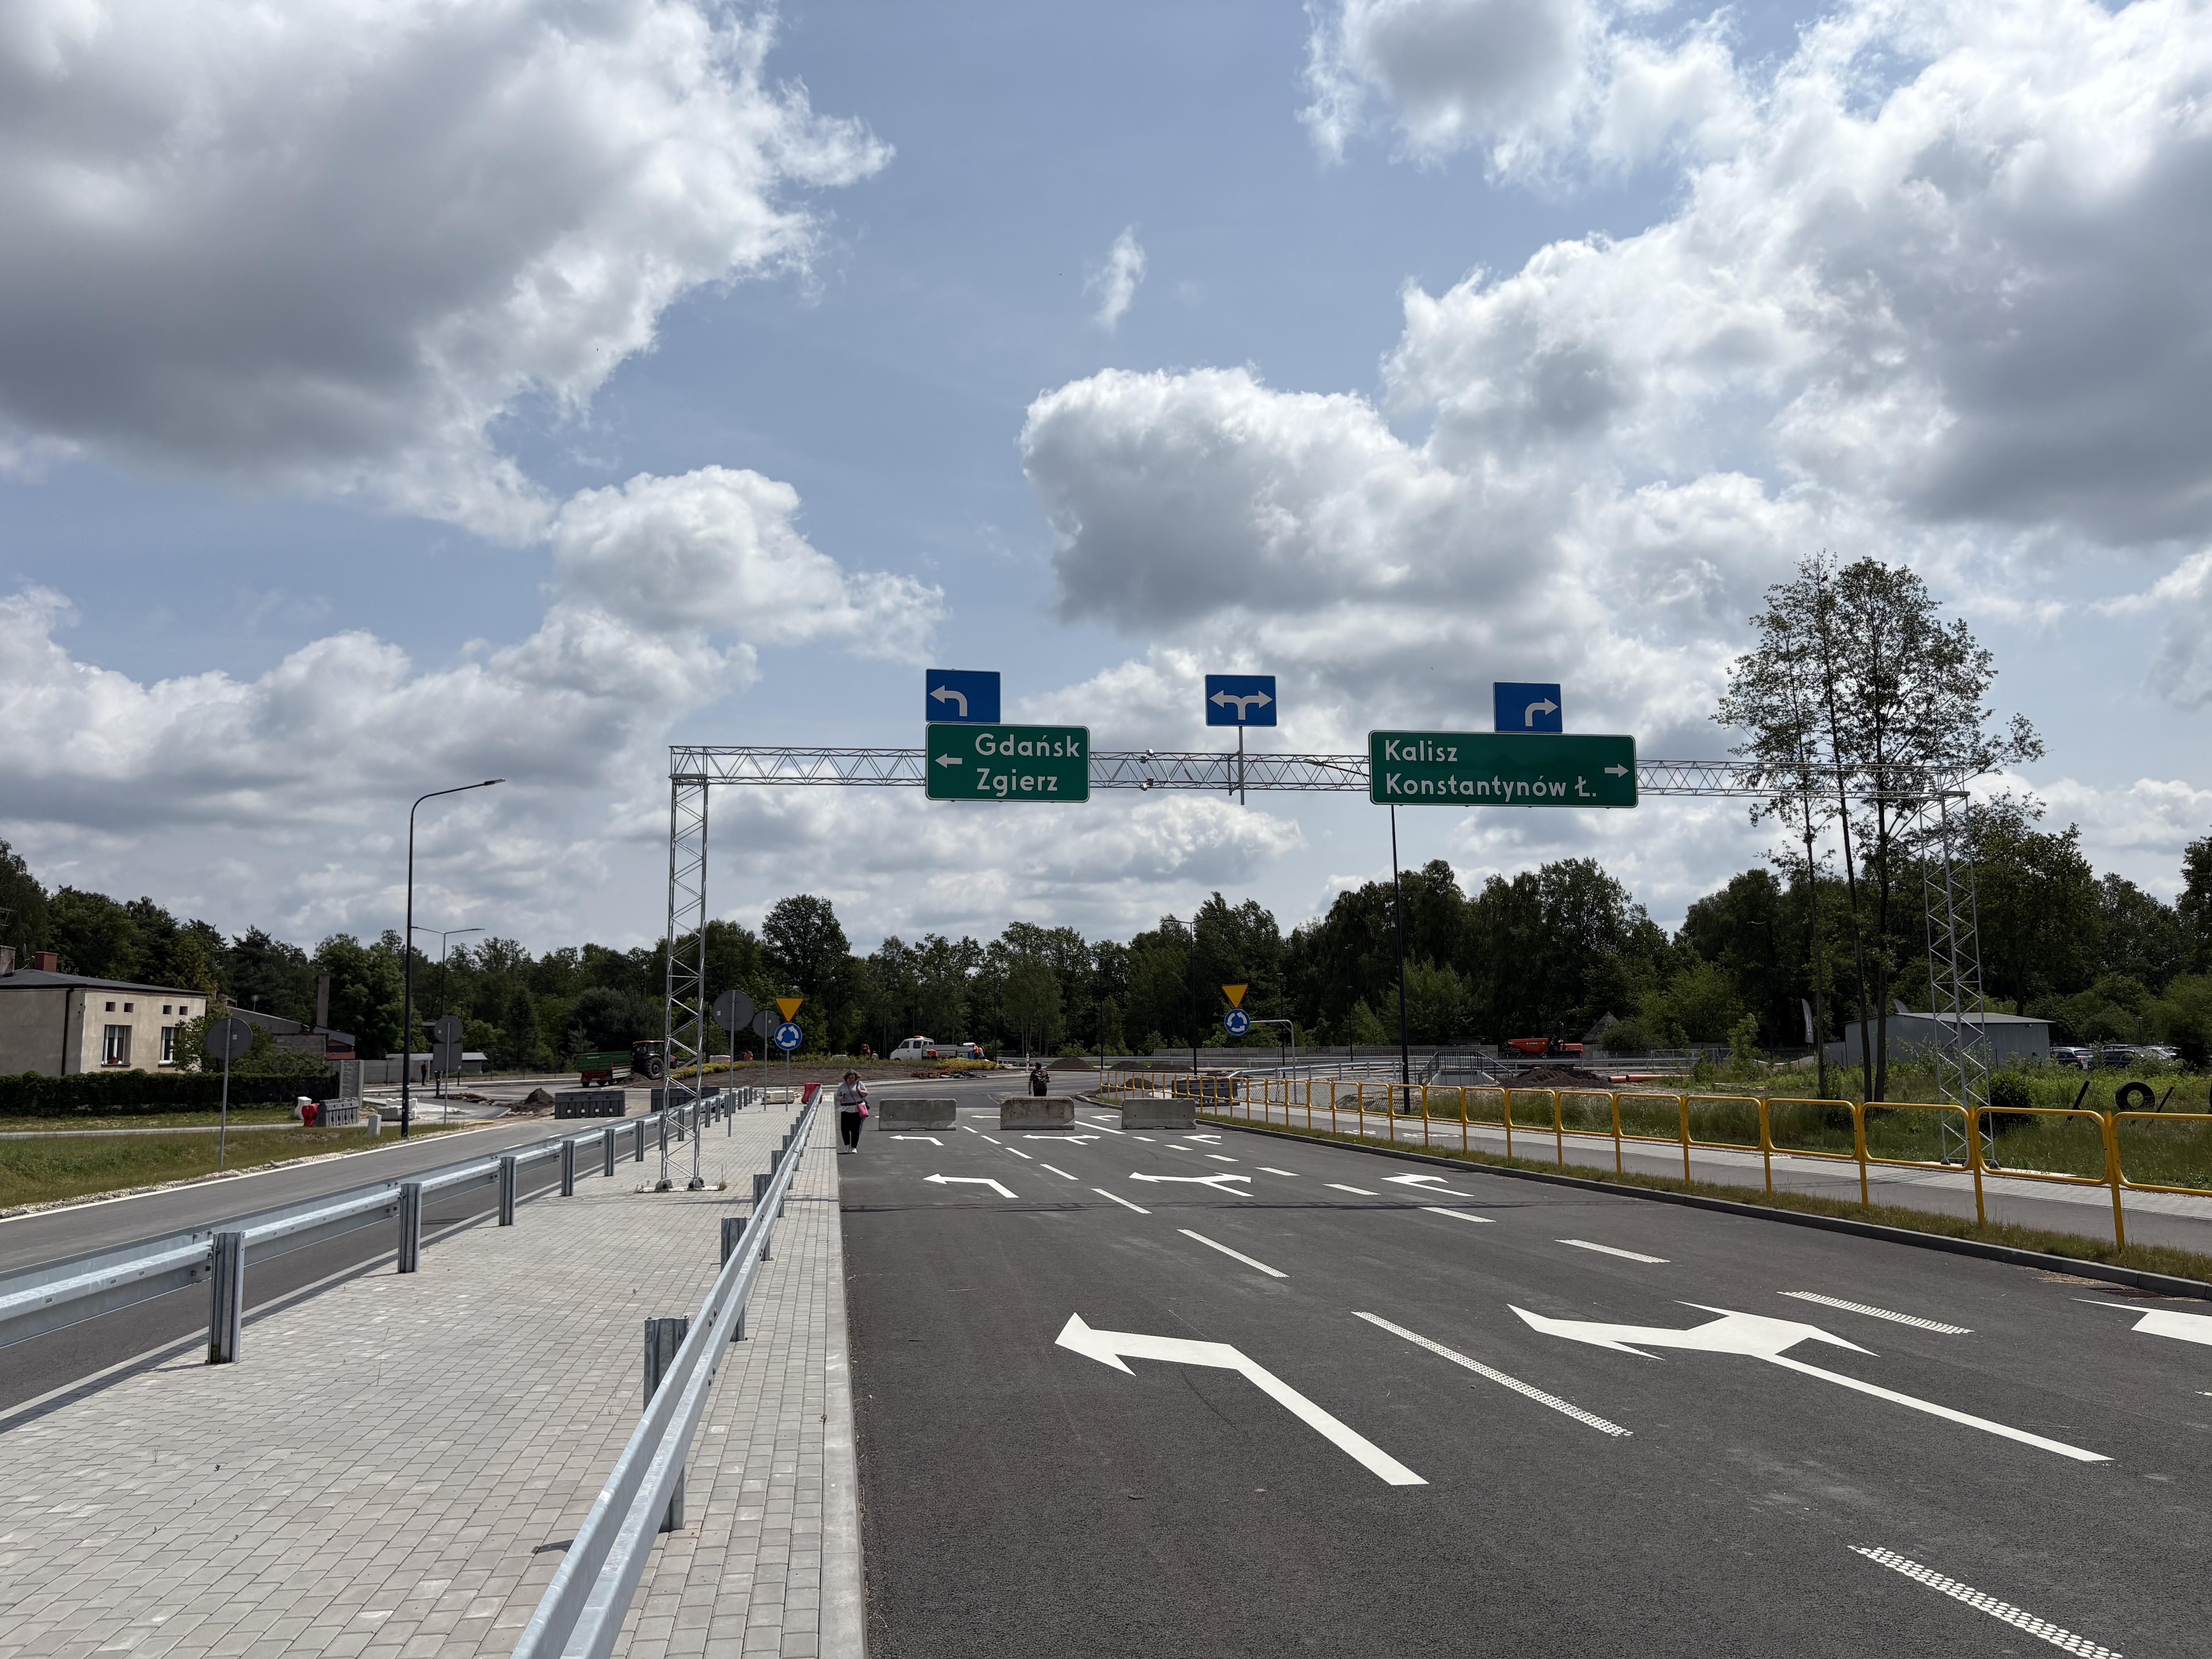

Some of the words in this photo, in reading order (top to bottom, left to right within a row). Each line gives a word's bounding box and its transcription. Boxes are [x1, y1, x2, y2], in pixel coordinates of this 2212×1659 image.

[975, 733, 1080, 757] Gdańsk
[1385, 740, 1457, 762] Kalisz
[977, 768, 1058, 797] Zgierz
[1386, 773, 1566, 802] Konstantynów
[1575, 776, 1596, 797] Ł.
